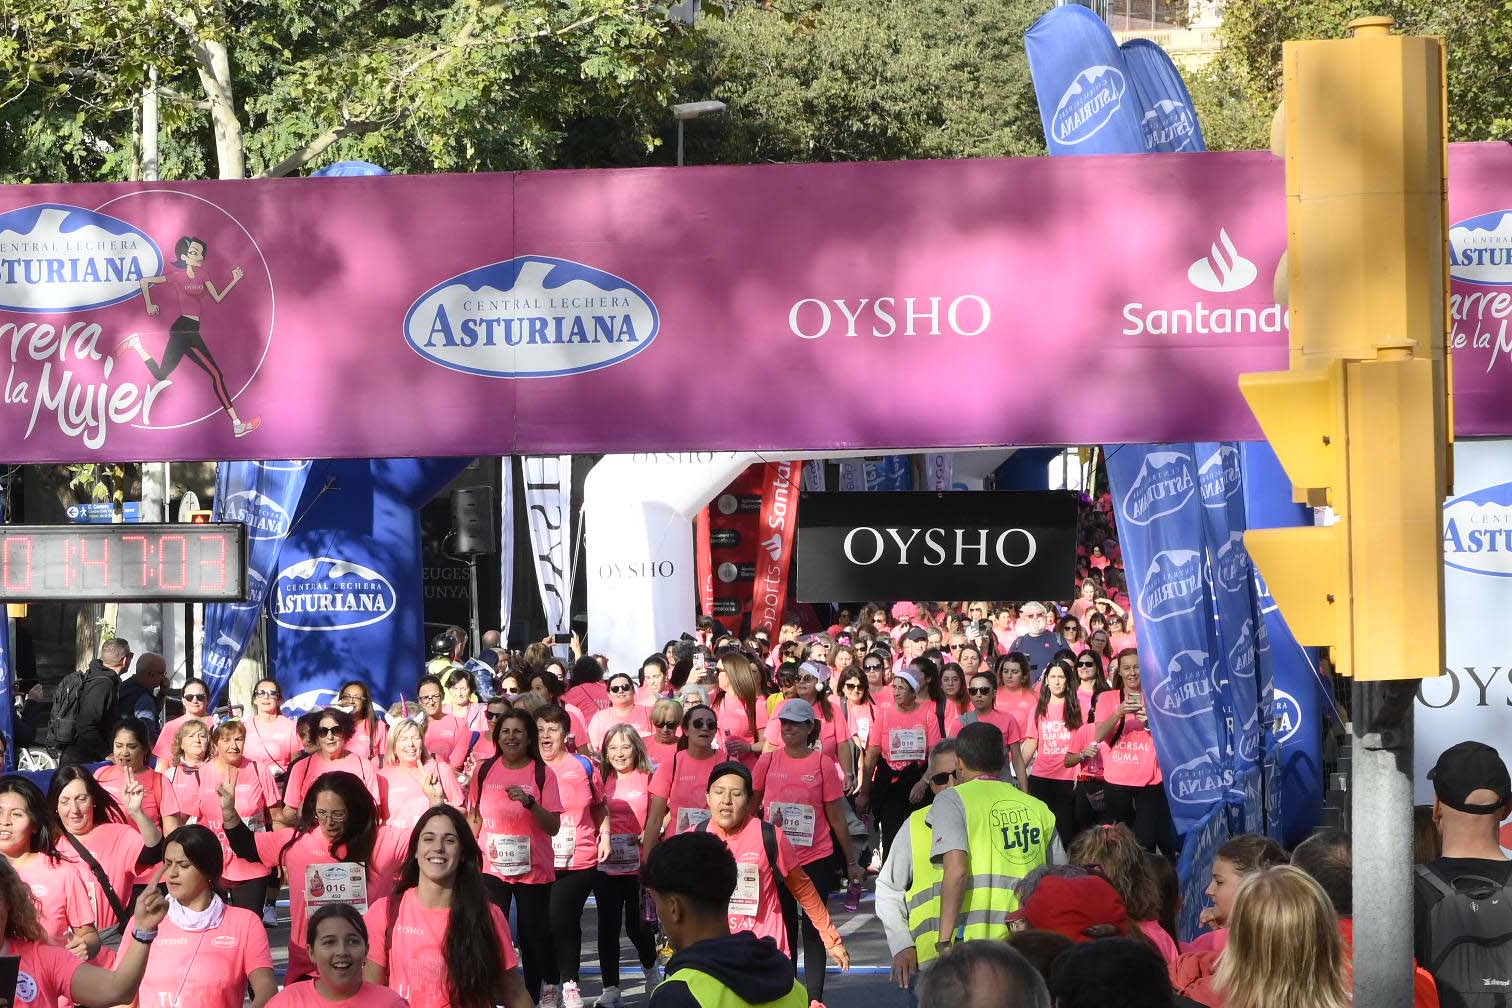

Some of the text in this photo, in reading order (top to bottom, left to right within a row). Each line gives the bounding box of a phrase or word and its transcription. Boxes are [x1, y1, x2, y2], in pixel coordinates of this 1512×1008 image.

[64, 239, 138, 251] LECHERA
[463, 296, 631, 311] CENTRAL LECHERA
[788, 295, 992, 340] OYSHO
[424, 303, 639, 348] ASTURIANA
[1122, 302, 1290, 337] Santand
[1473, 320, 1491, 350] la
[4, 363, 29, 405] la
[23, 356, 173, 450] Mujer
[843, 527, 1038, 568] OYSHO
[599, 560, 675, 579] OYSHO
[274, 587, 388, 615] ASTURIANA
[286, 582, 329, 592] CENTRAL
[991, 806, 1032, 828] Sport
[1000, 823, 1041, 853] Life
[326, 884, 346, 892] 016
[157, 991, 182, 1008] TU
[399, 984, 410, 1000] U
